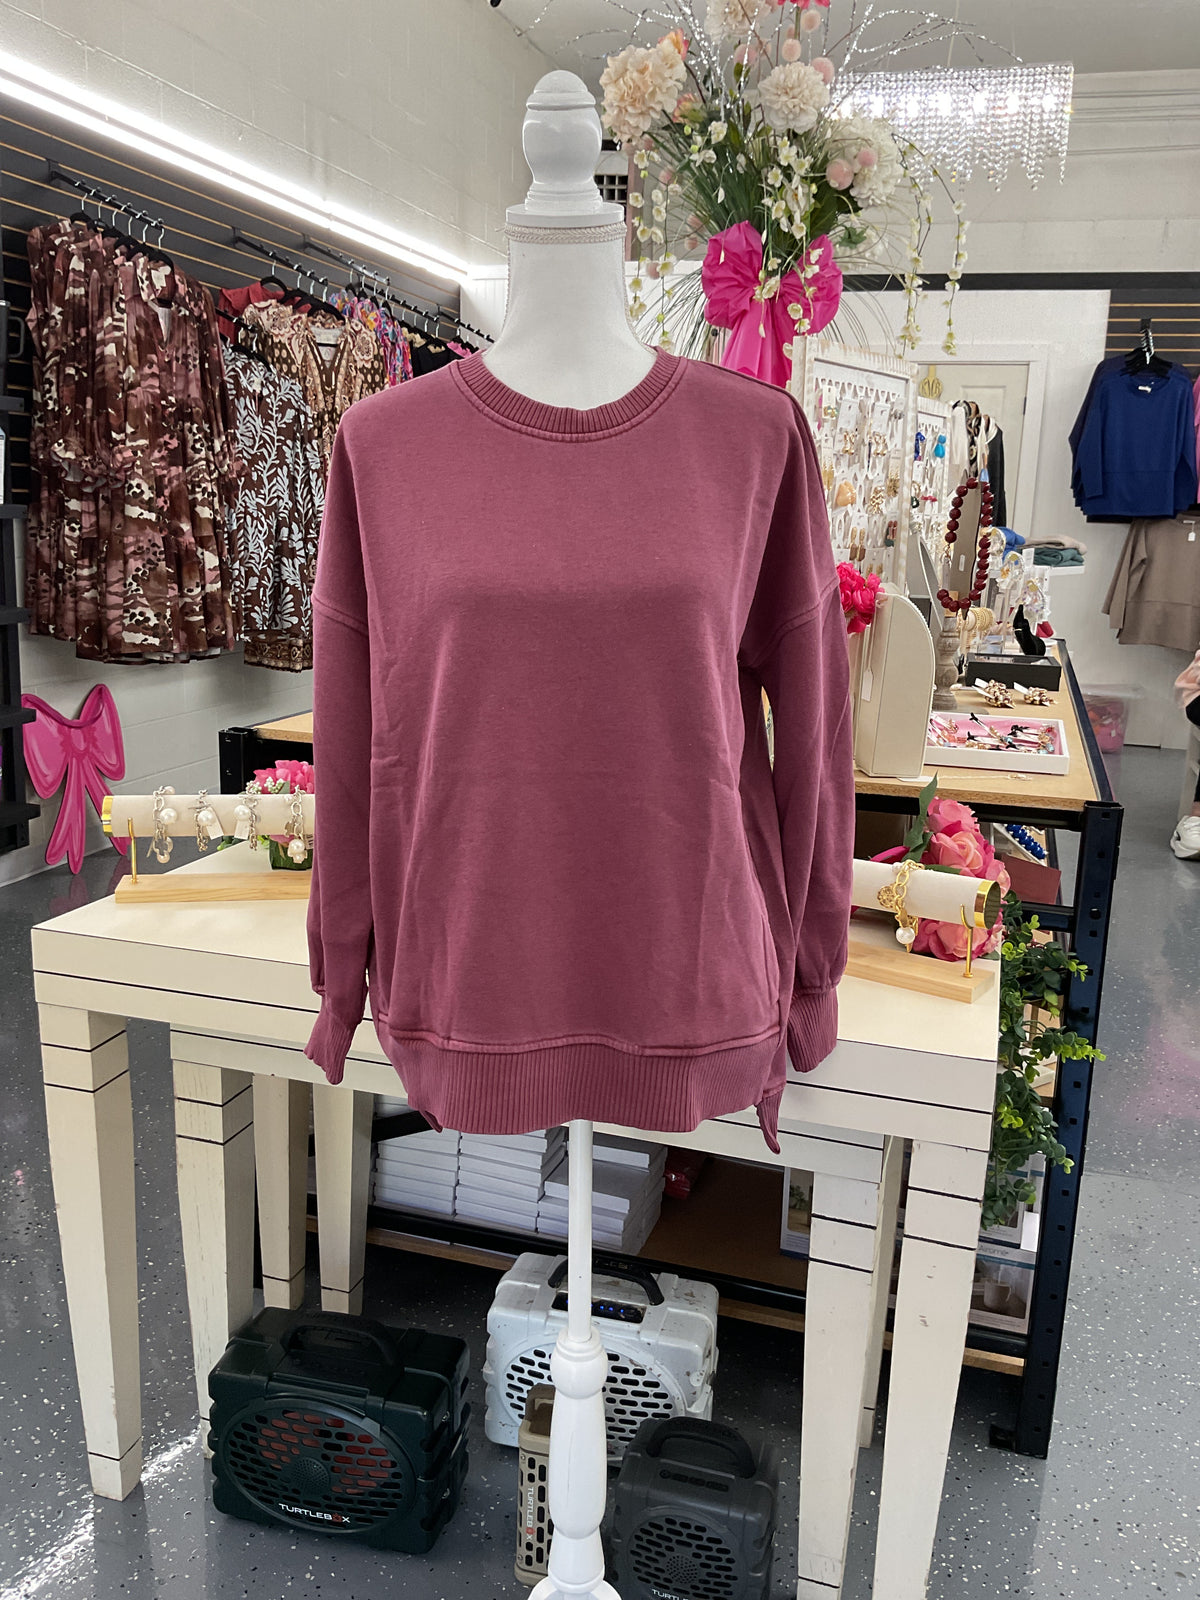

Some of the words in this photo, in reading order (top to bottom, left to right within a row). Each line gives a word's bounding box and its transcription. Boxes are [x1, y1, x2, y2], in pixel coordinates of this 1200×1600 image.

[278, 1503, 351, 1523] TURTLEBOX
[526, 1486, 536, 1540] TURTLEBOX
[651, 1588, 689, 1600] TURTL
